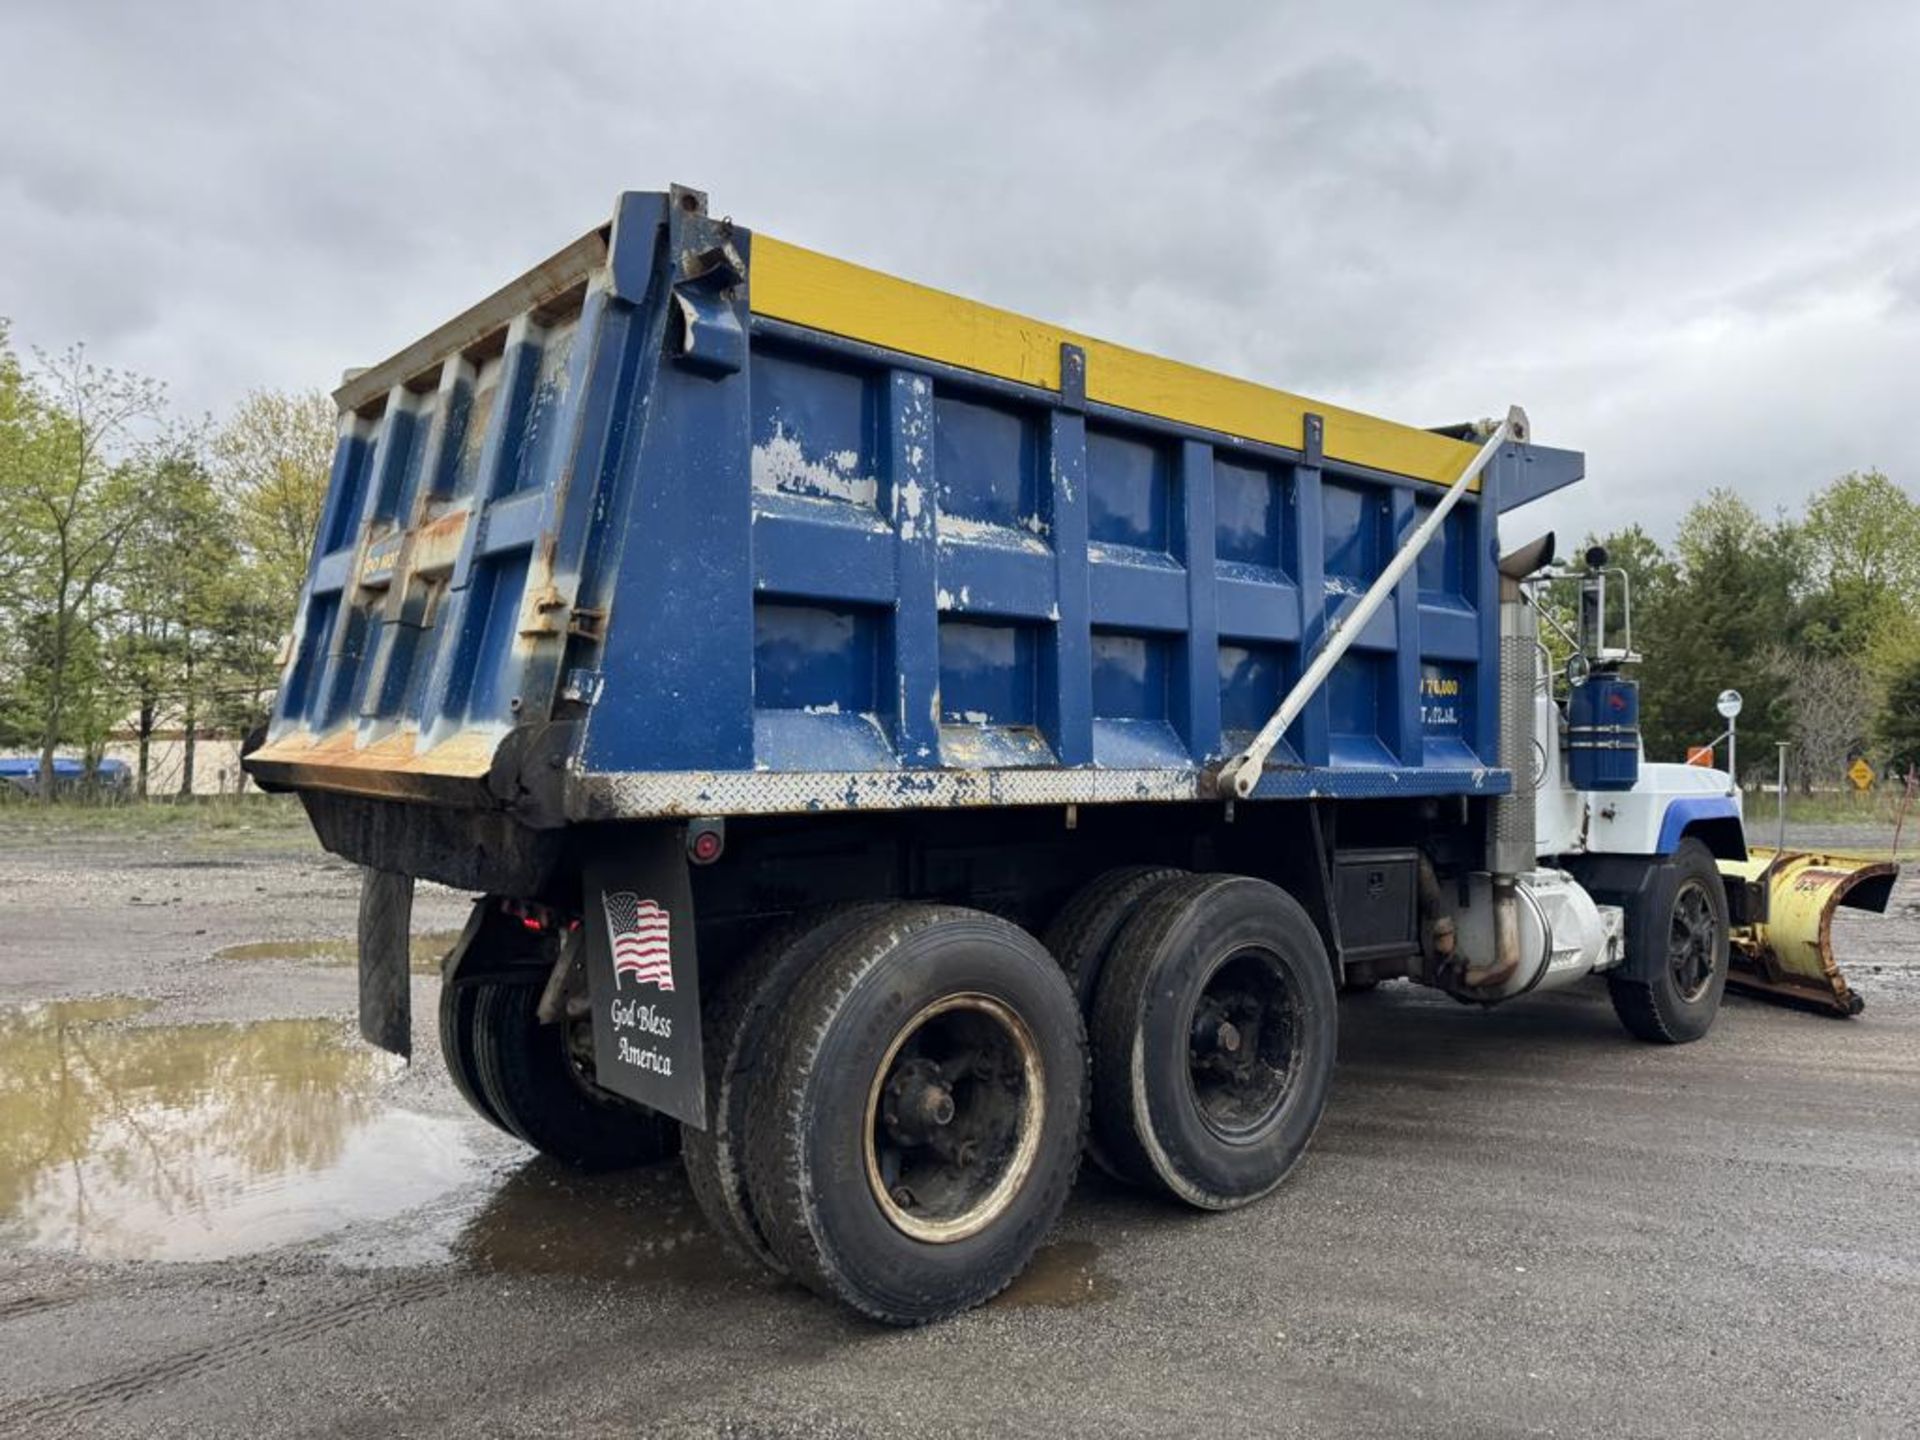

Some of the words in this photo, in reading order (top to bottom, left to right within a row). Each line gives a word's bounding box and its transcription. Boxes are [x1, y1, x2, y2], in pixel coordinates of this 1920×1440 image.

[611, 998, 637, 1032] God
[637, 1004, 672, 1038] Bless
[618, 1036, 673, 1077] America
